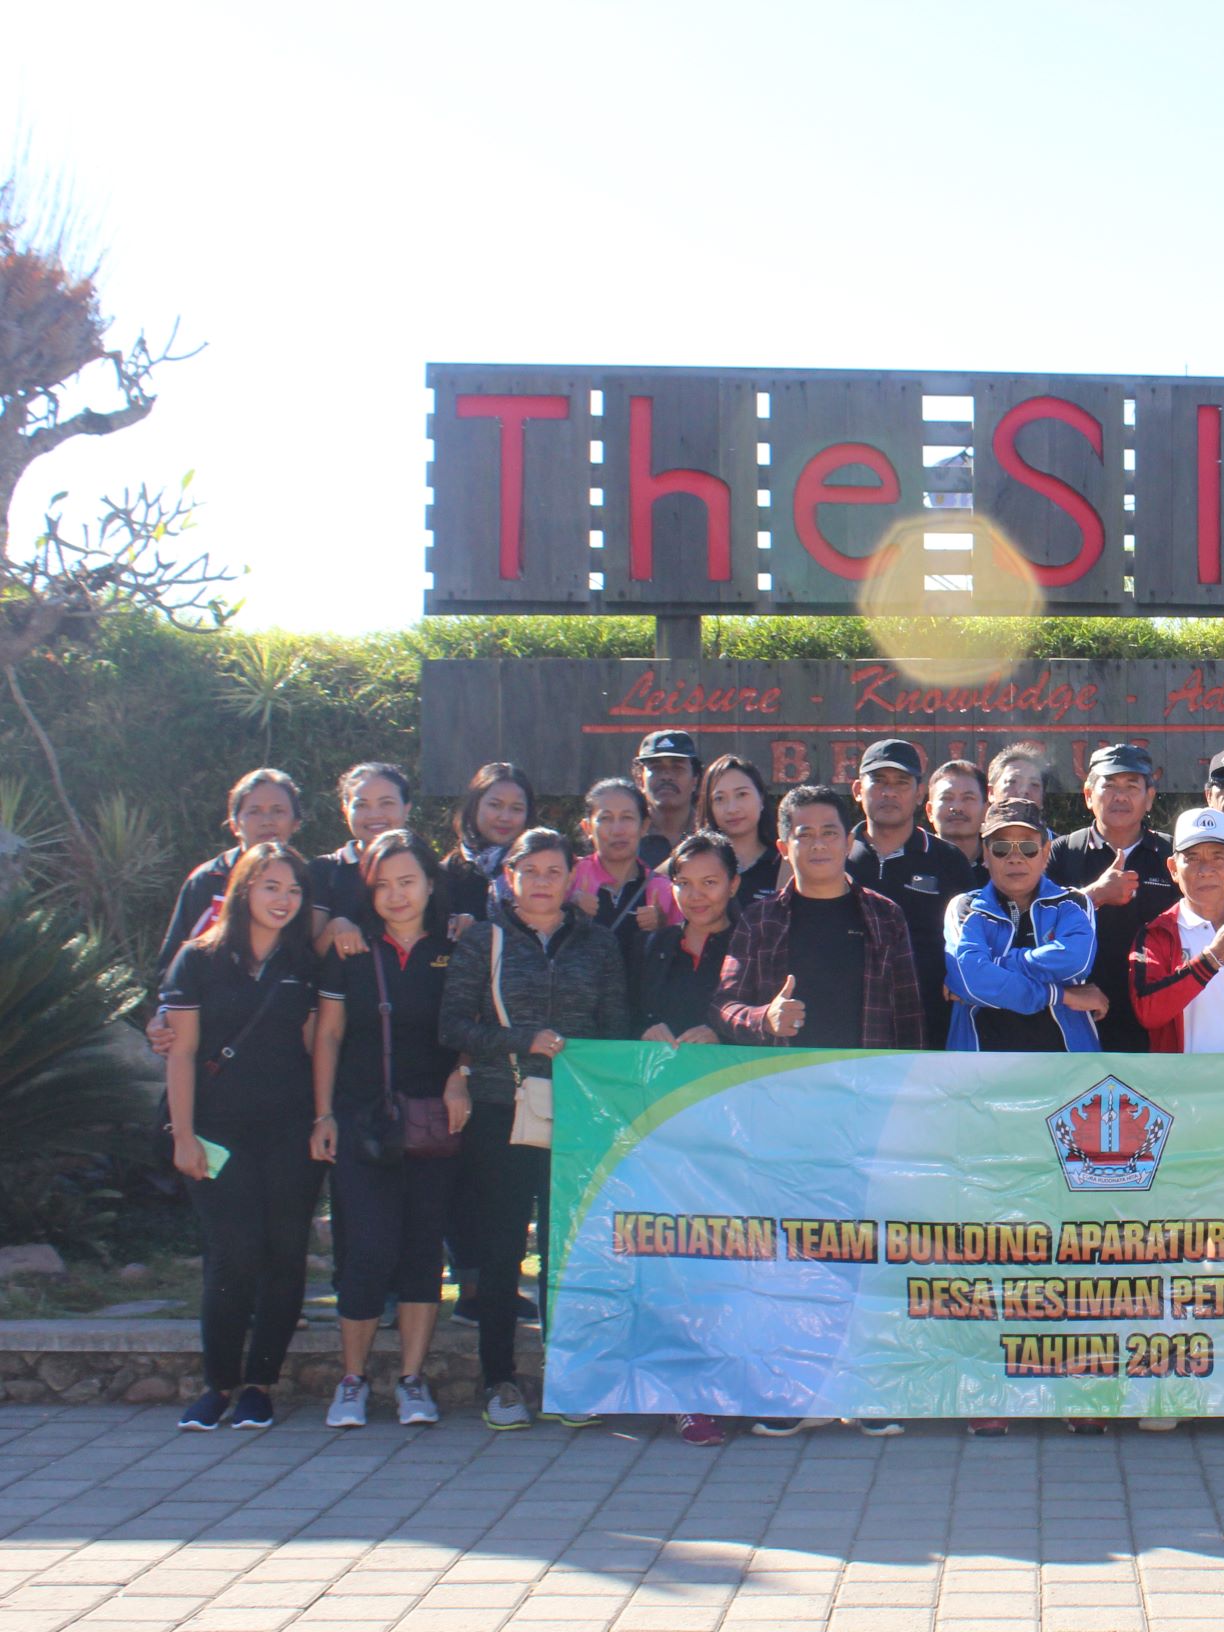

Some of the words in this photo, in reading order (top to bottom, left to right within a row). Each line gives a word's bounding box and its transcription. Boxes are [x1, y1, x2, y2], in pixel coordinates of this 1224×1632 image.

[456, 395, 901, 581] The
[609, 670, 782, 716] Leisure
[850, 664, 1098, 721] Knowledge
[614, 1211, 777, 1261] KEGIATAN
[781, 1218, 878, 1264] TEAM
[885, 1221, 1052, 1264] BUILDING
[907, 1277, 999, 1320] DESA
[1002, 1276, 1164, 1320] KESIMAN
[1000, 1334, 1119, 1378] TAHUN
[1126, 1332, 1214, 1378] 2019
